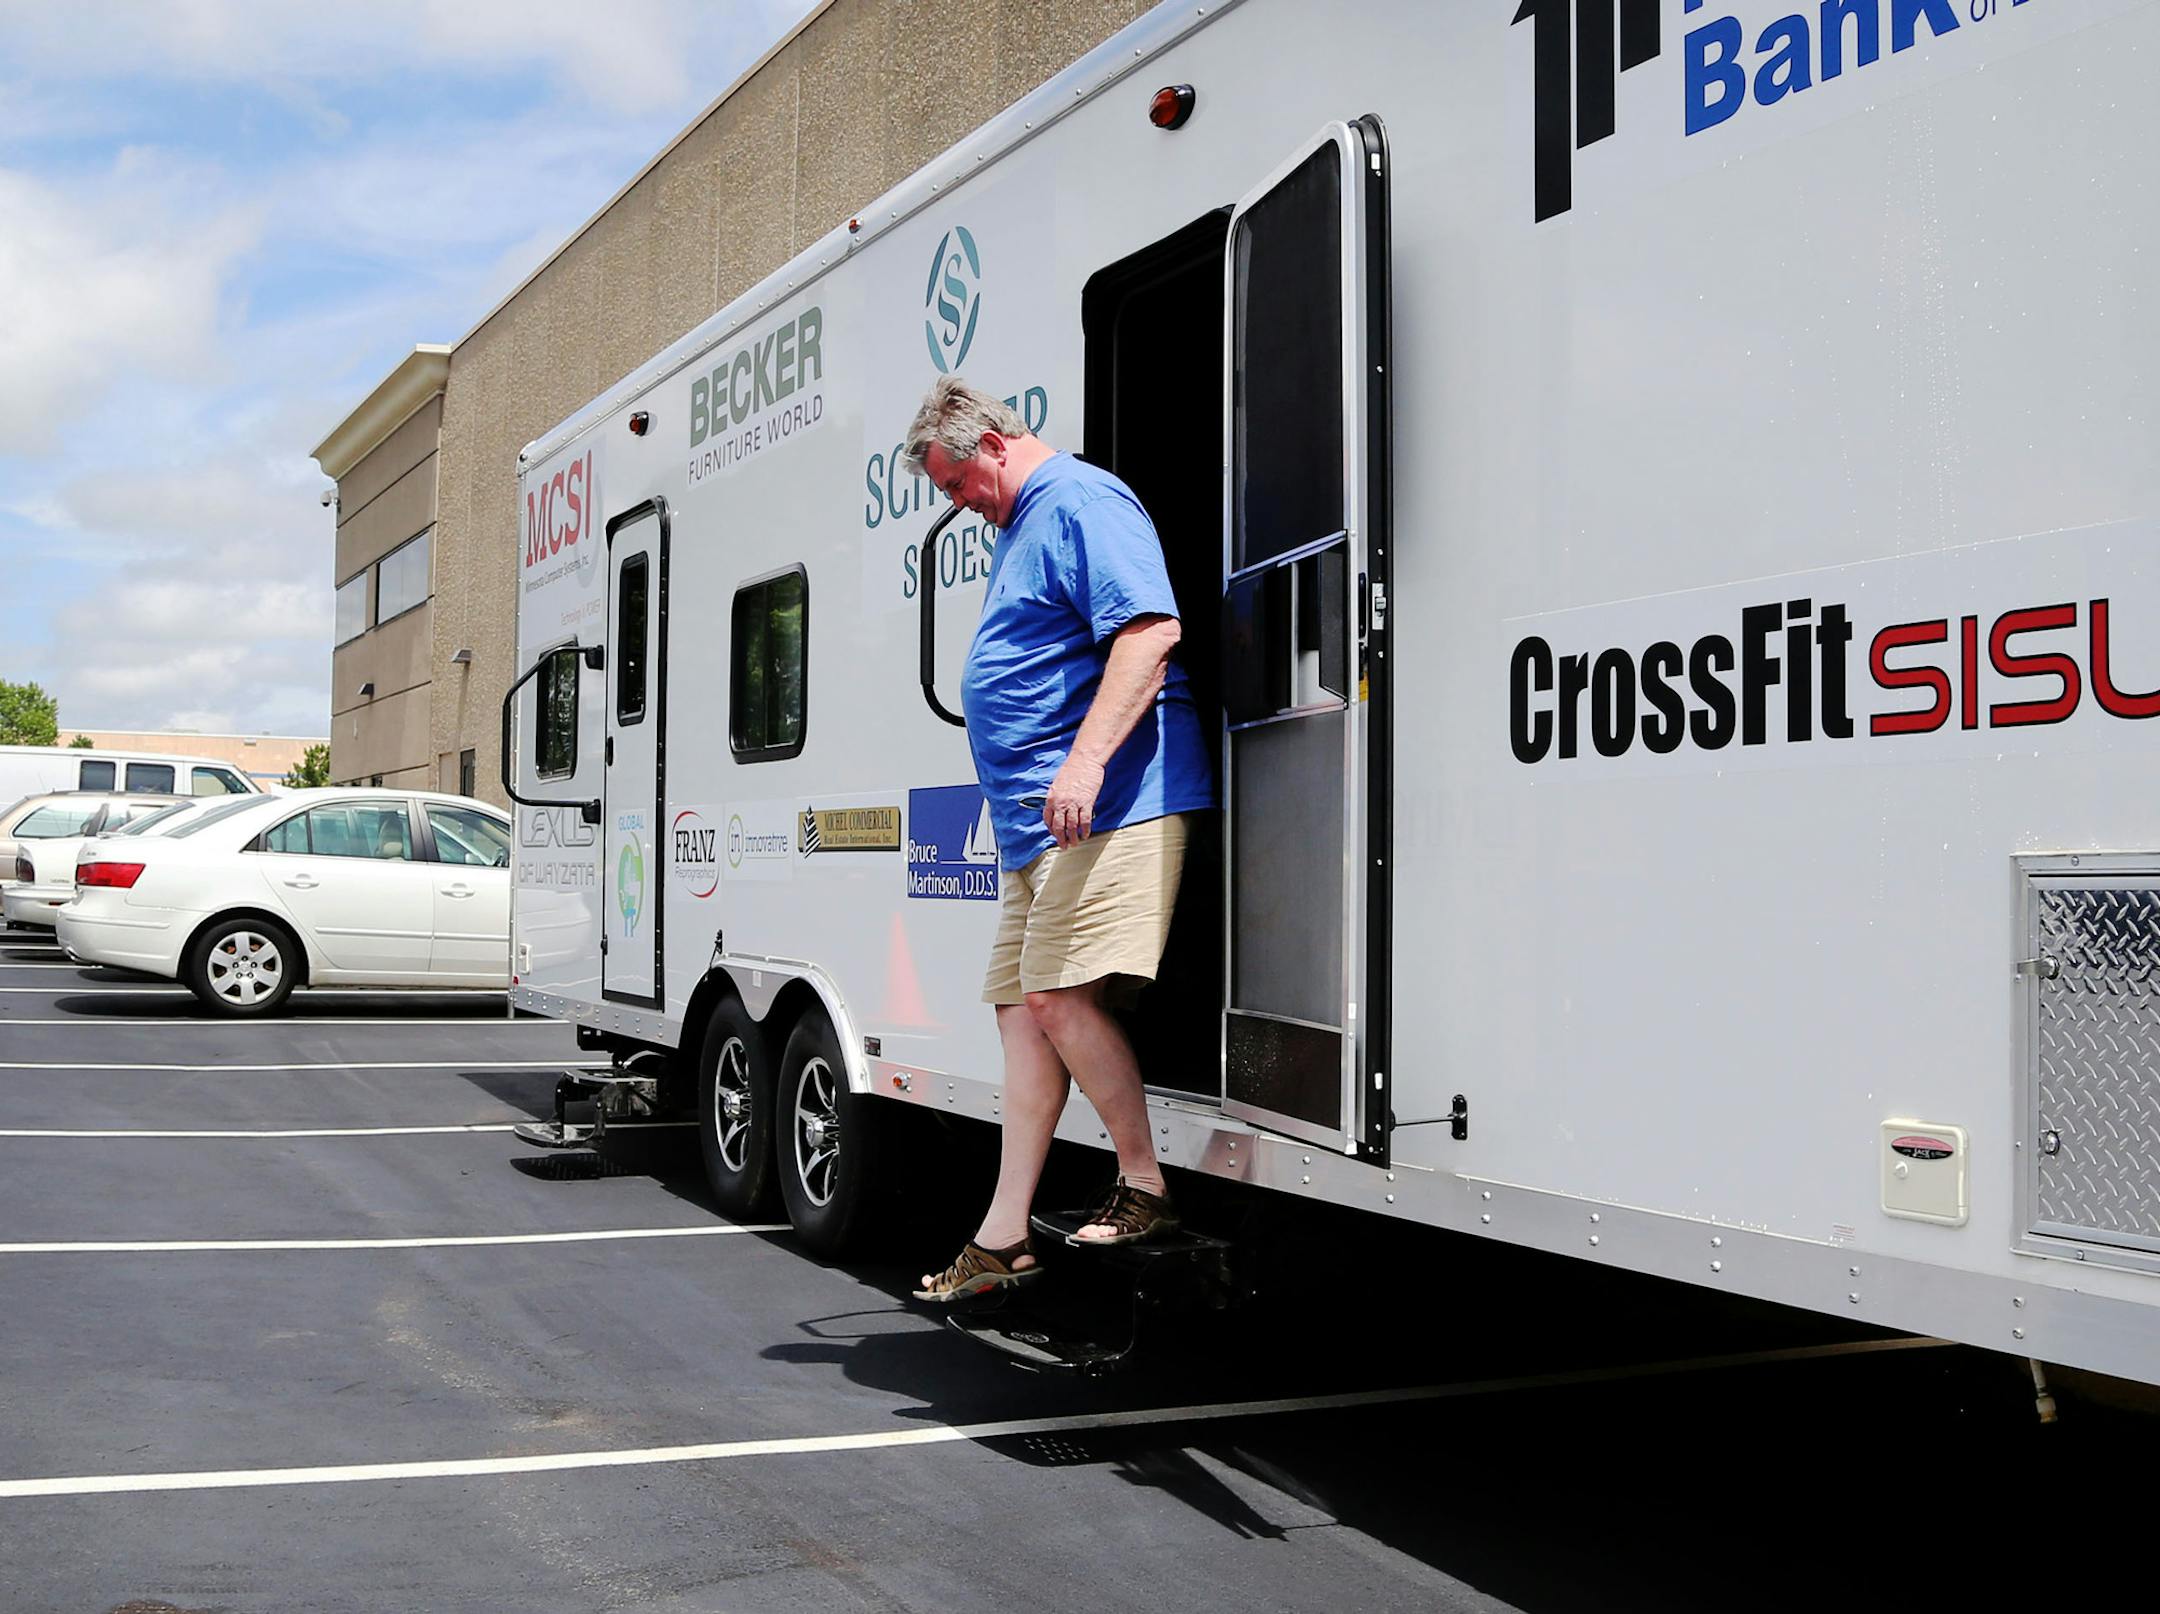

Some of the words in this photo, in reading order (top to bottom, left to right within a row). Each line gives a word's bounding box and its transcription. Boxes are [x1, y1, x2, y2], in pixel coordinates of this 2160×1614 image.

[690, 306, 823, 449] BECKER
[688, 430, 761, 485] FURNITURE
[767, 394, 823, 444] WORLD
[526, 450, 592, 568] MCSI
[903, 521, 997, 599] SOES
[1509, 597, 1854, 765] CrossFit
[619, 815, 644, 831] GLOBAL
[850, 809, 893, 830] COMMERCIAL
[675, 829, 716, 863] FRANZ
[745, 831, 788, 852] innovative
[909, 839, 938, 863] Bruce
[520, 862, 534, 884] OF
[535, 862, 595, 885] WAYZATA
[909, 870, 962, 898] Martinson,
[965, 870, 997, 897] D.D.S.
